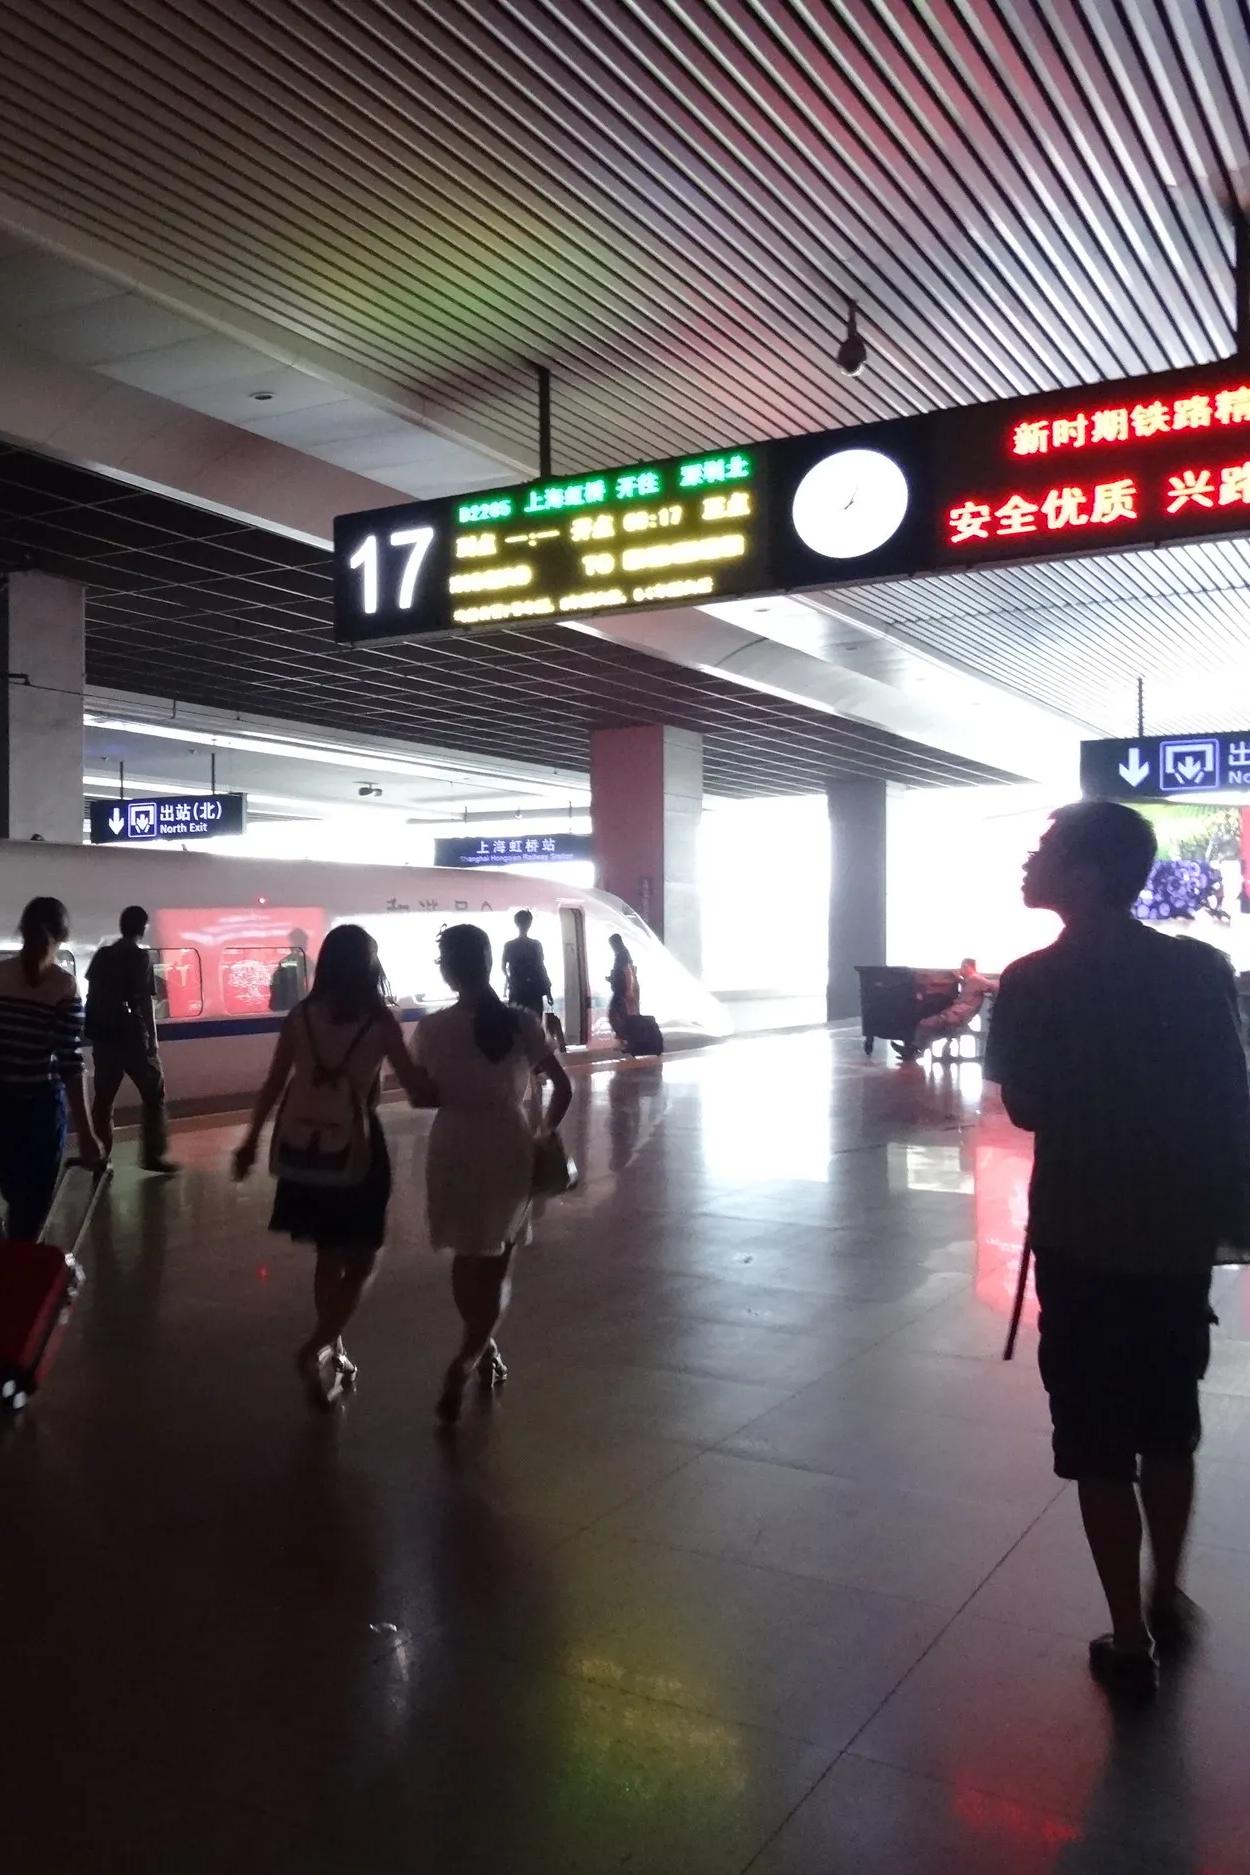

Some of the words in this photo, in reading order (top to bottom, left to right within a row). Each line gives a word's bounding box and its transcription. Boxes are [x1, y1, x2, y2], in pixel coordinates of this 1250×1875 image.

[1012, 386, 1250, 456] 新时期铁路精
[949, 478, 1138, 544] 安全优质
[350, 526, 435, 615] 17
[1228, 742, 1250, 766] 出
[160, 801, 223, 822] 出站(北)
[160, 823, 187, 834] North
[190, 822, 208, 832] Exit
[476, 838, 556, 854] 上海虹桥站
